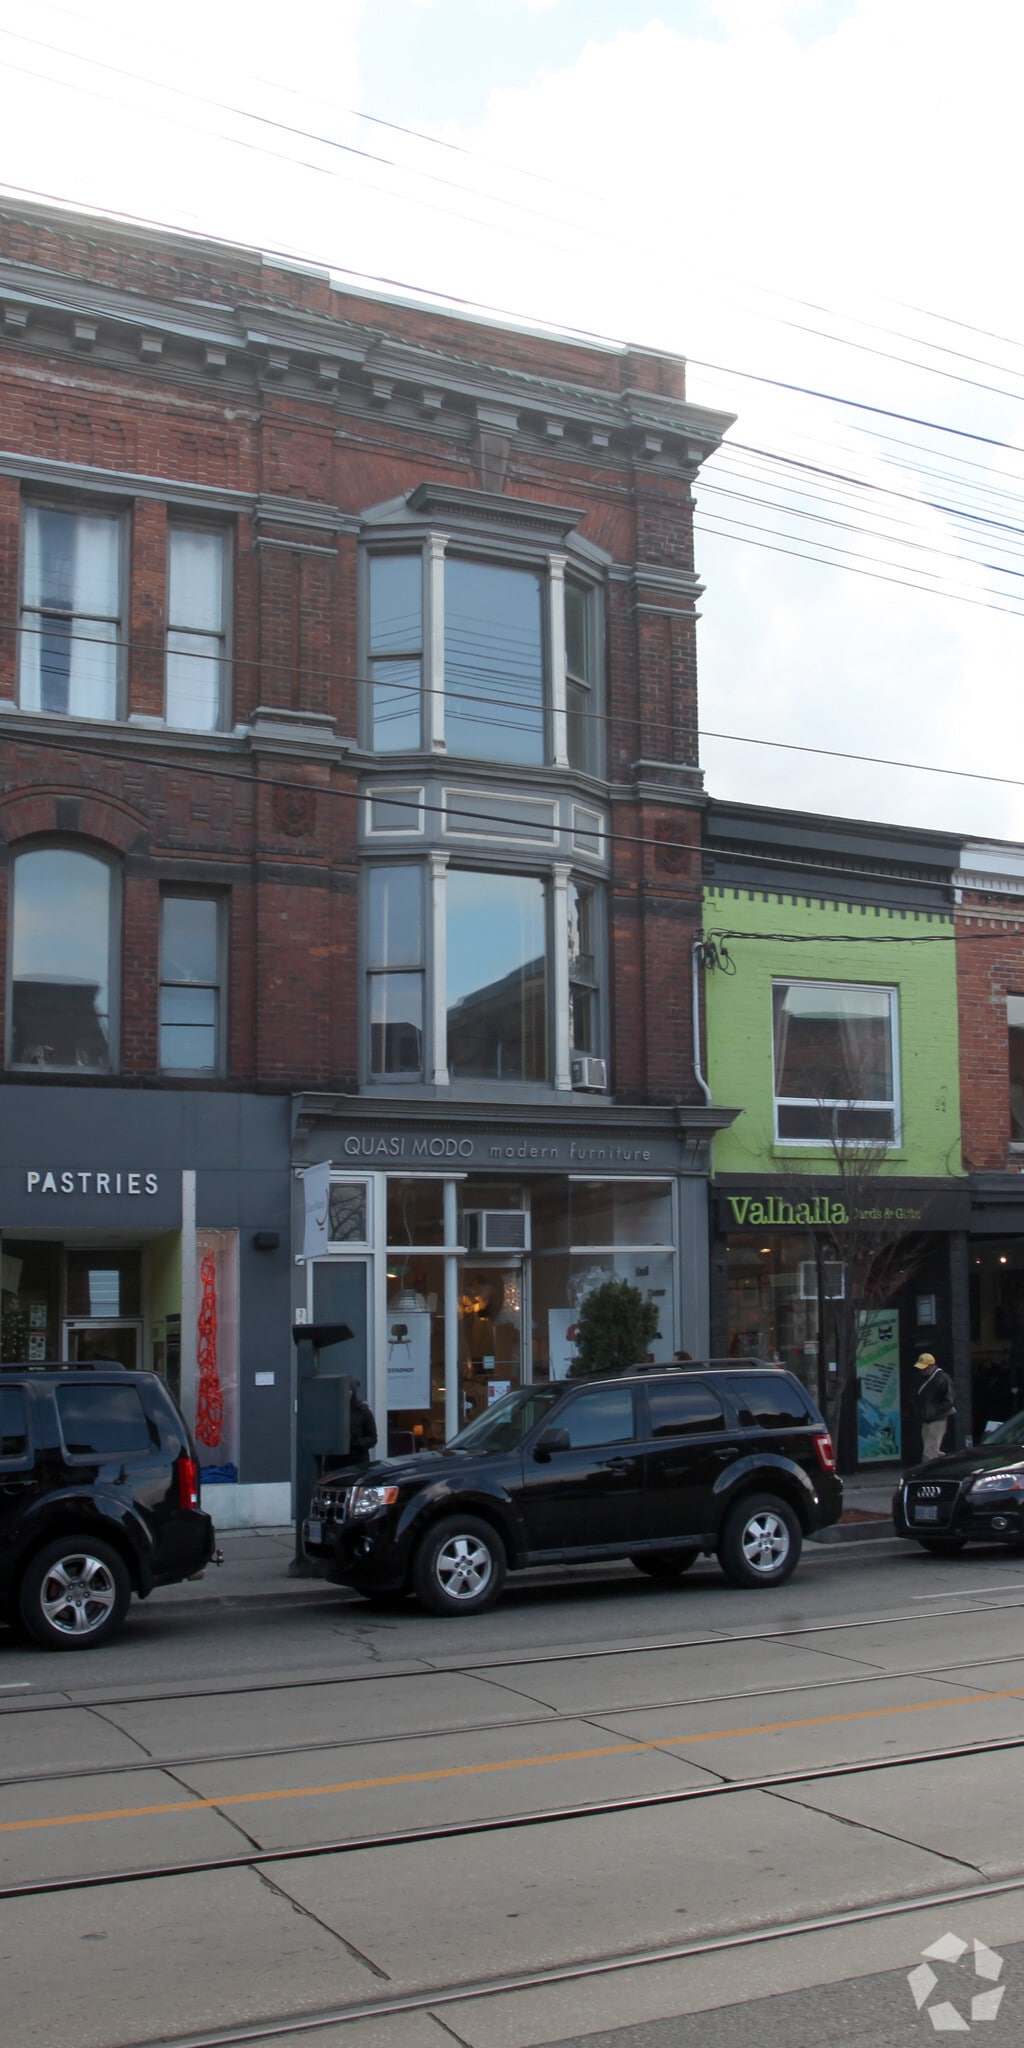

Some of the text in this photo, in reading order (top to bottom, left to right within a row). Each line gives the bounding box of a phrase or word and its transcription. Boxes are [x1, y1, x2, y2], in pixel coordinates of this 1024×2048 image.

[344, 1136, 651, 1161] QUASI MODO modern furniture
[27, 1171, 158, 1194] PASTRIES
[726, 1196, 849, 1225] Valhalla
